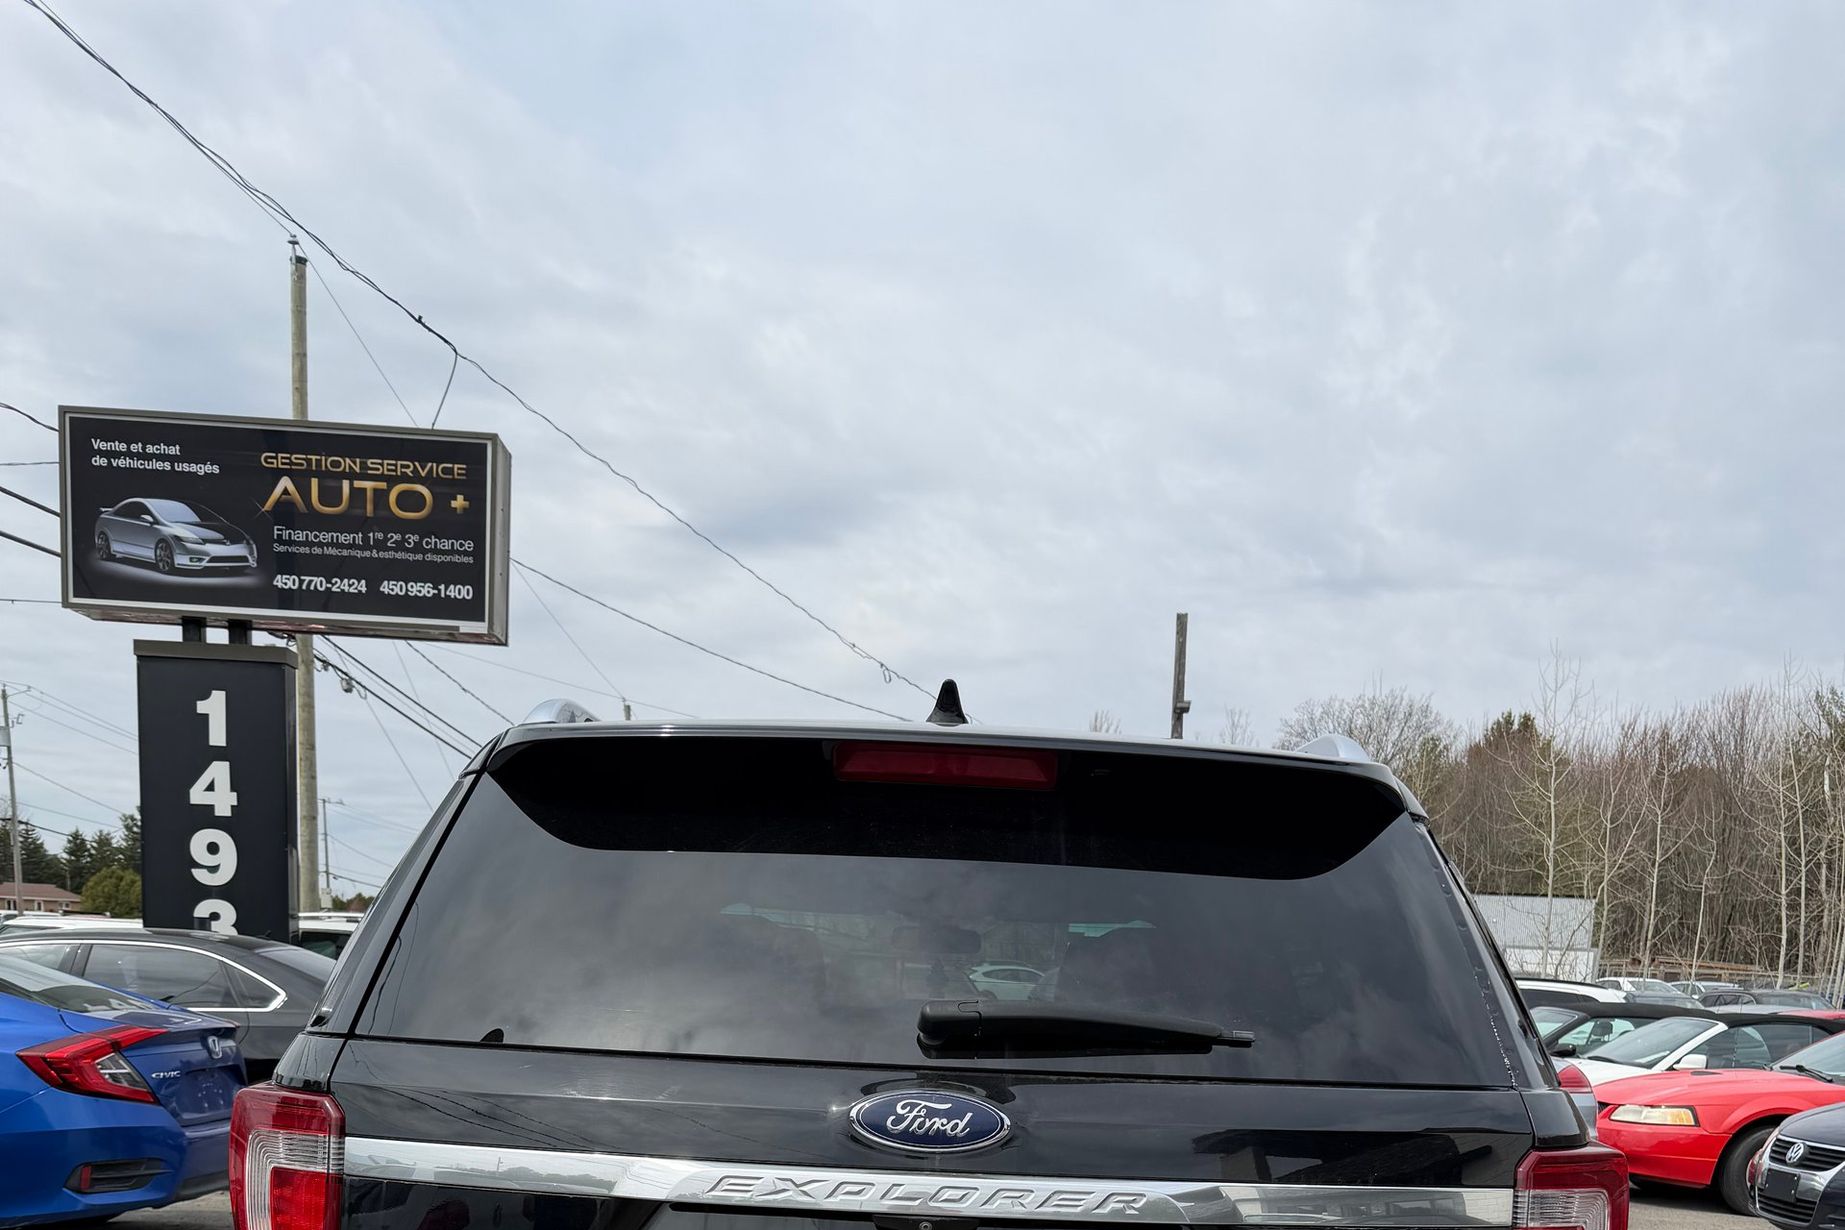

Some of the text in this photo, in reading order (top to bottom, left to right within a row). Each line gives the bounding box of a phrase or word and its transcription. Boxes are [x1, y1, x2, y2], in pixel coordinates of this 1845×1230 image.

[91, 438, 181, 455] Vente et achat
[91, 455, 220, 476] de véhicules usagés
[261, 452, 467, 479] GESTION SERVICE
[263, 475, 434, 520] AUTO
[273, 525, 363, 545] Financement
[422, 535, 474, 551] chance
[273, 543, 310, 554] Services
[311, 546, 322, 555] de
[323, 546, 371, 558] Mécanique
[378, 549, 423, 561] esthétique
[424, 552, 474, 563] disponibles
[273, 574, 473, 600] 450 770-2424 450 956-1400
[151, 1070, 181, 1079] CIVIC
[886, 1099, 974, 1137] Ford
[704, 1174, 1149, 1216] EXPLORER
